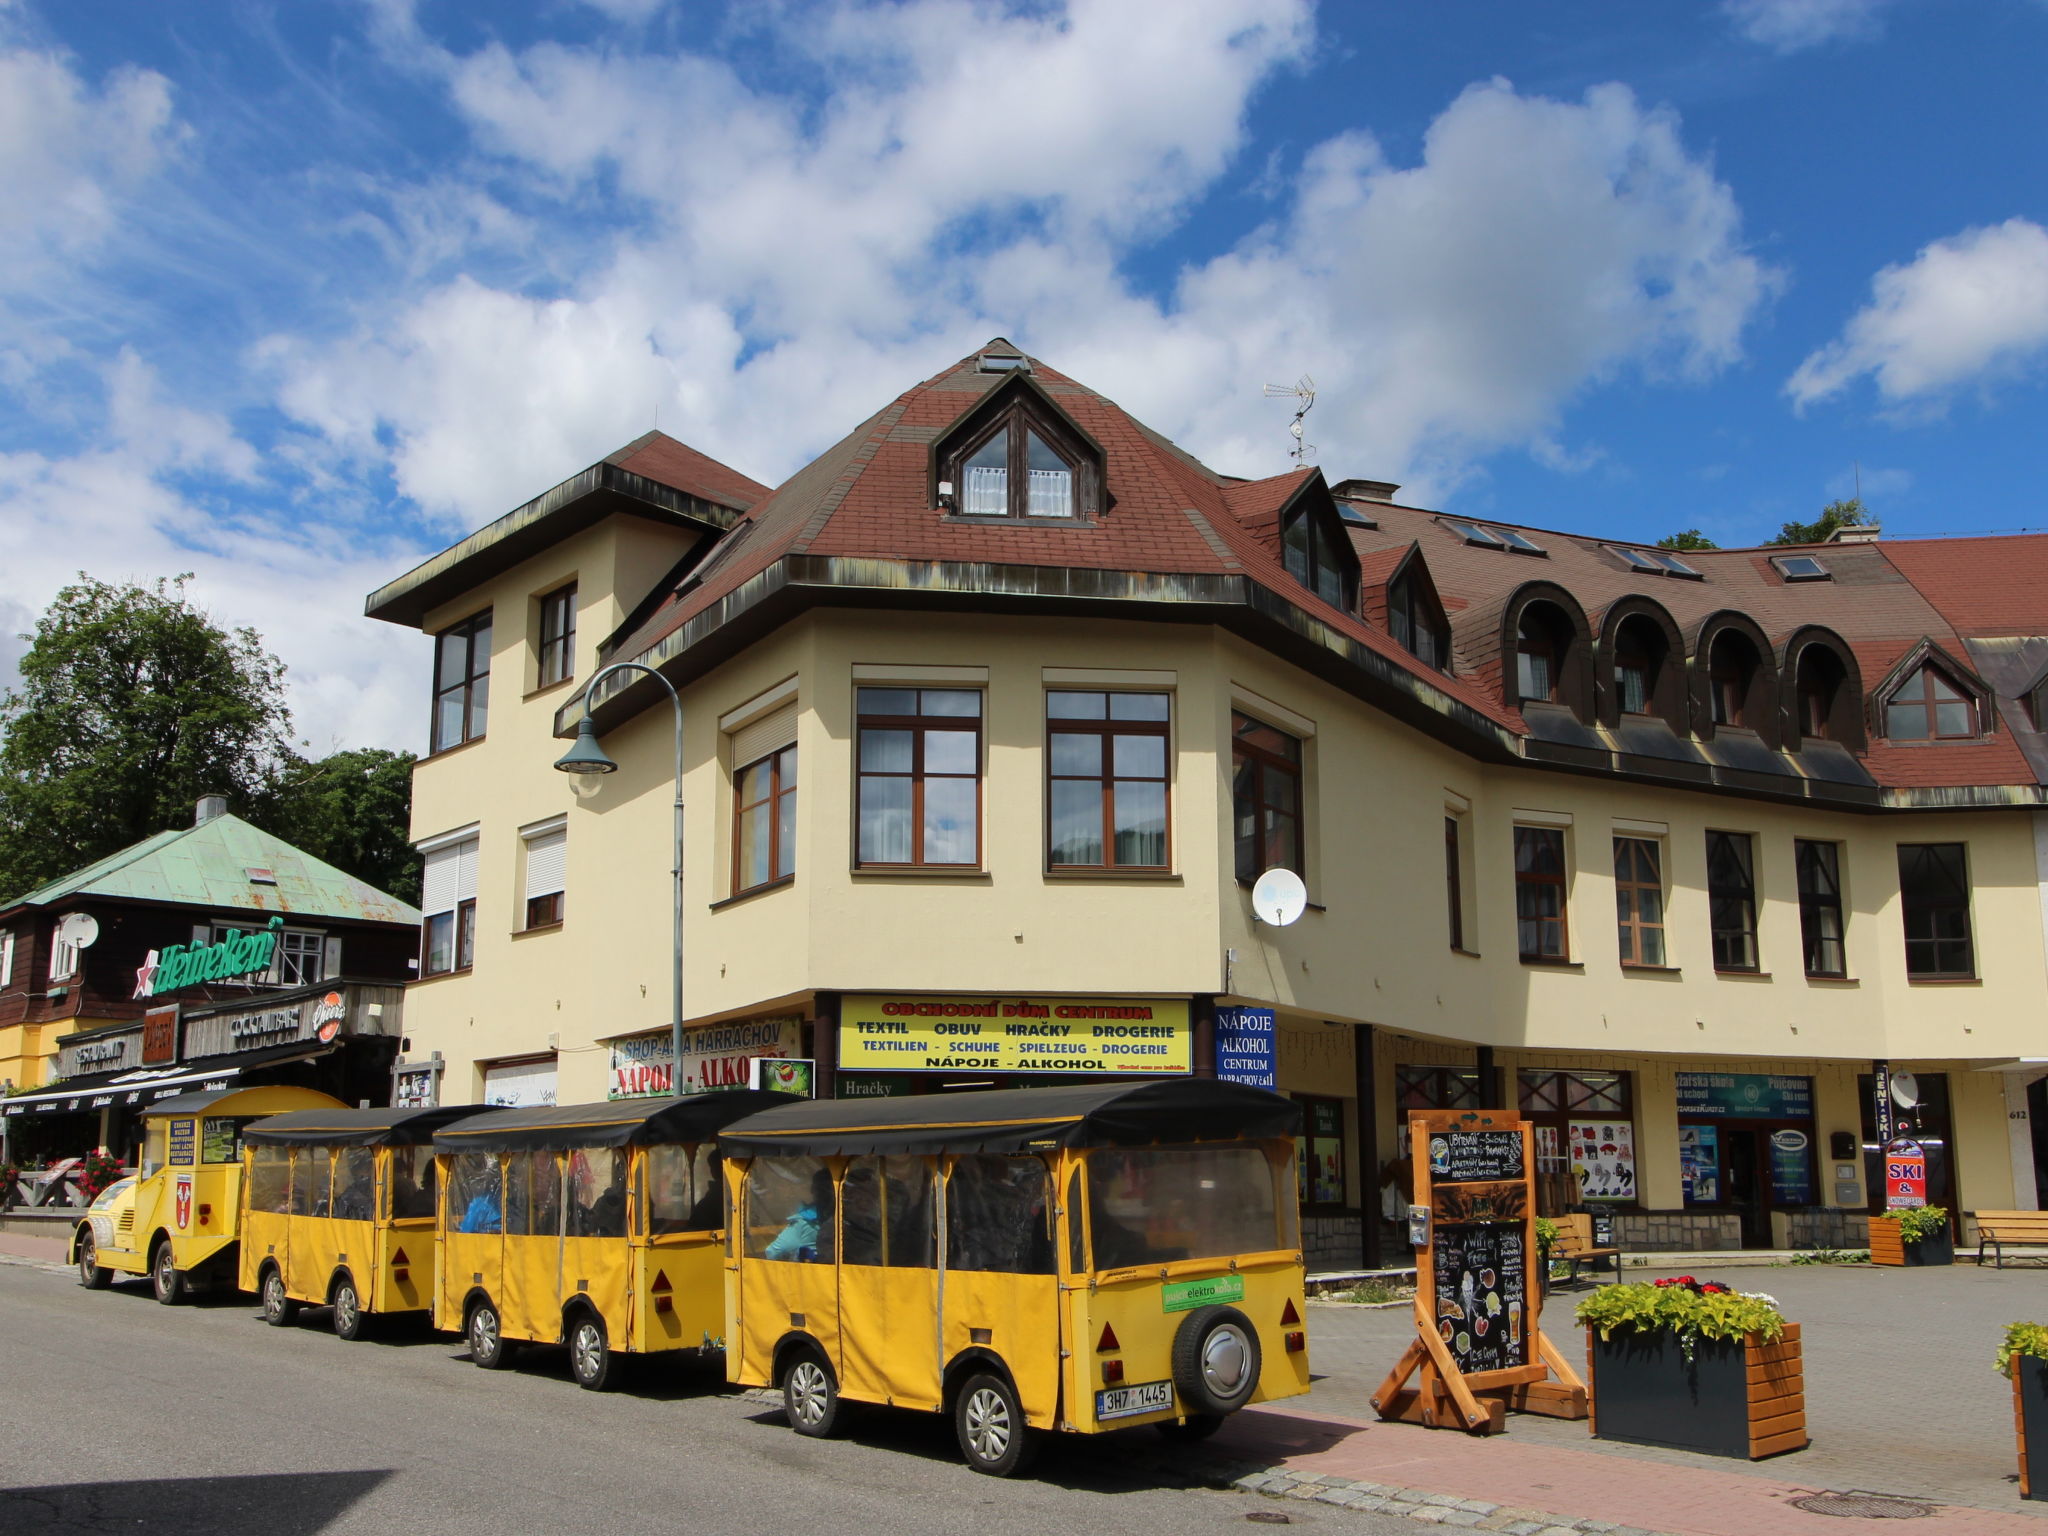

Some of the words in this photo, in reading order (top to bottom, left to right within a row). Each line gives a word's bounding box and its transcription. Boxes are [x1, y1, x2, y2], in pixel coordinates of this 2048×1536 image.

[152, 928, 275, 995] Heineken
[881, 1001, 1000, 1018] OBCHODNÍ
[1002, 1000, 1050, 1018] DŮM
[1055, 1005, 1153, 1020] CENTRUM
[856, 1021, 910, 1035] TEXTIL
[934, 1022, 982, 1036] OBUV
[1005, 1020, 1071, 1038] HRAČKY
[1092, 1024, 1175, 1039] DROGERIE
[1218, 1011, 1272, 1031] NÁPOJE
[696, 1023, 783, 1053] HARRACHOV
[1221, 1037, 1270, 1054] ALKOHOL
[862, 1040, 928, 1052] TEXTILIEN
[949, 1041, 1001, 1053] SCHUHE
[1018, 1042, 1088, 1055] SPIELZEUG
[1101, 1043, 1168, 1056] DROGERIE
[925, 1056, 1000, 1068] NÁPOJE
[1017, 1058, 1106, 1070] ALKOHOL
[1223, 1058, 1268, 1071] CENTRUM
[845, 1080, 892, 1097] Hračky
[1876, 1073, 1887, 1107] RENT
[2009, 1111, 2027, 1120] 612
[1879, 1114, 1890, 1141] SKI
[1888, 1163, 1923, 1180] SKI
[1899, 1182, 1913, 1194] &
[1469, 1347, 1483, 1361] ICE
[1107, 1390, 1129, 1410] 3H7
[1138, 1385, 1166, 1406] 1445
